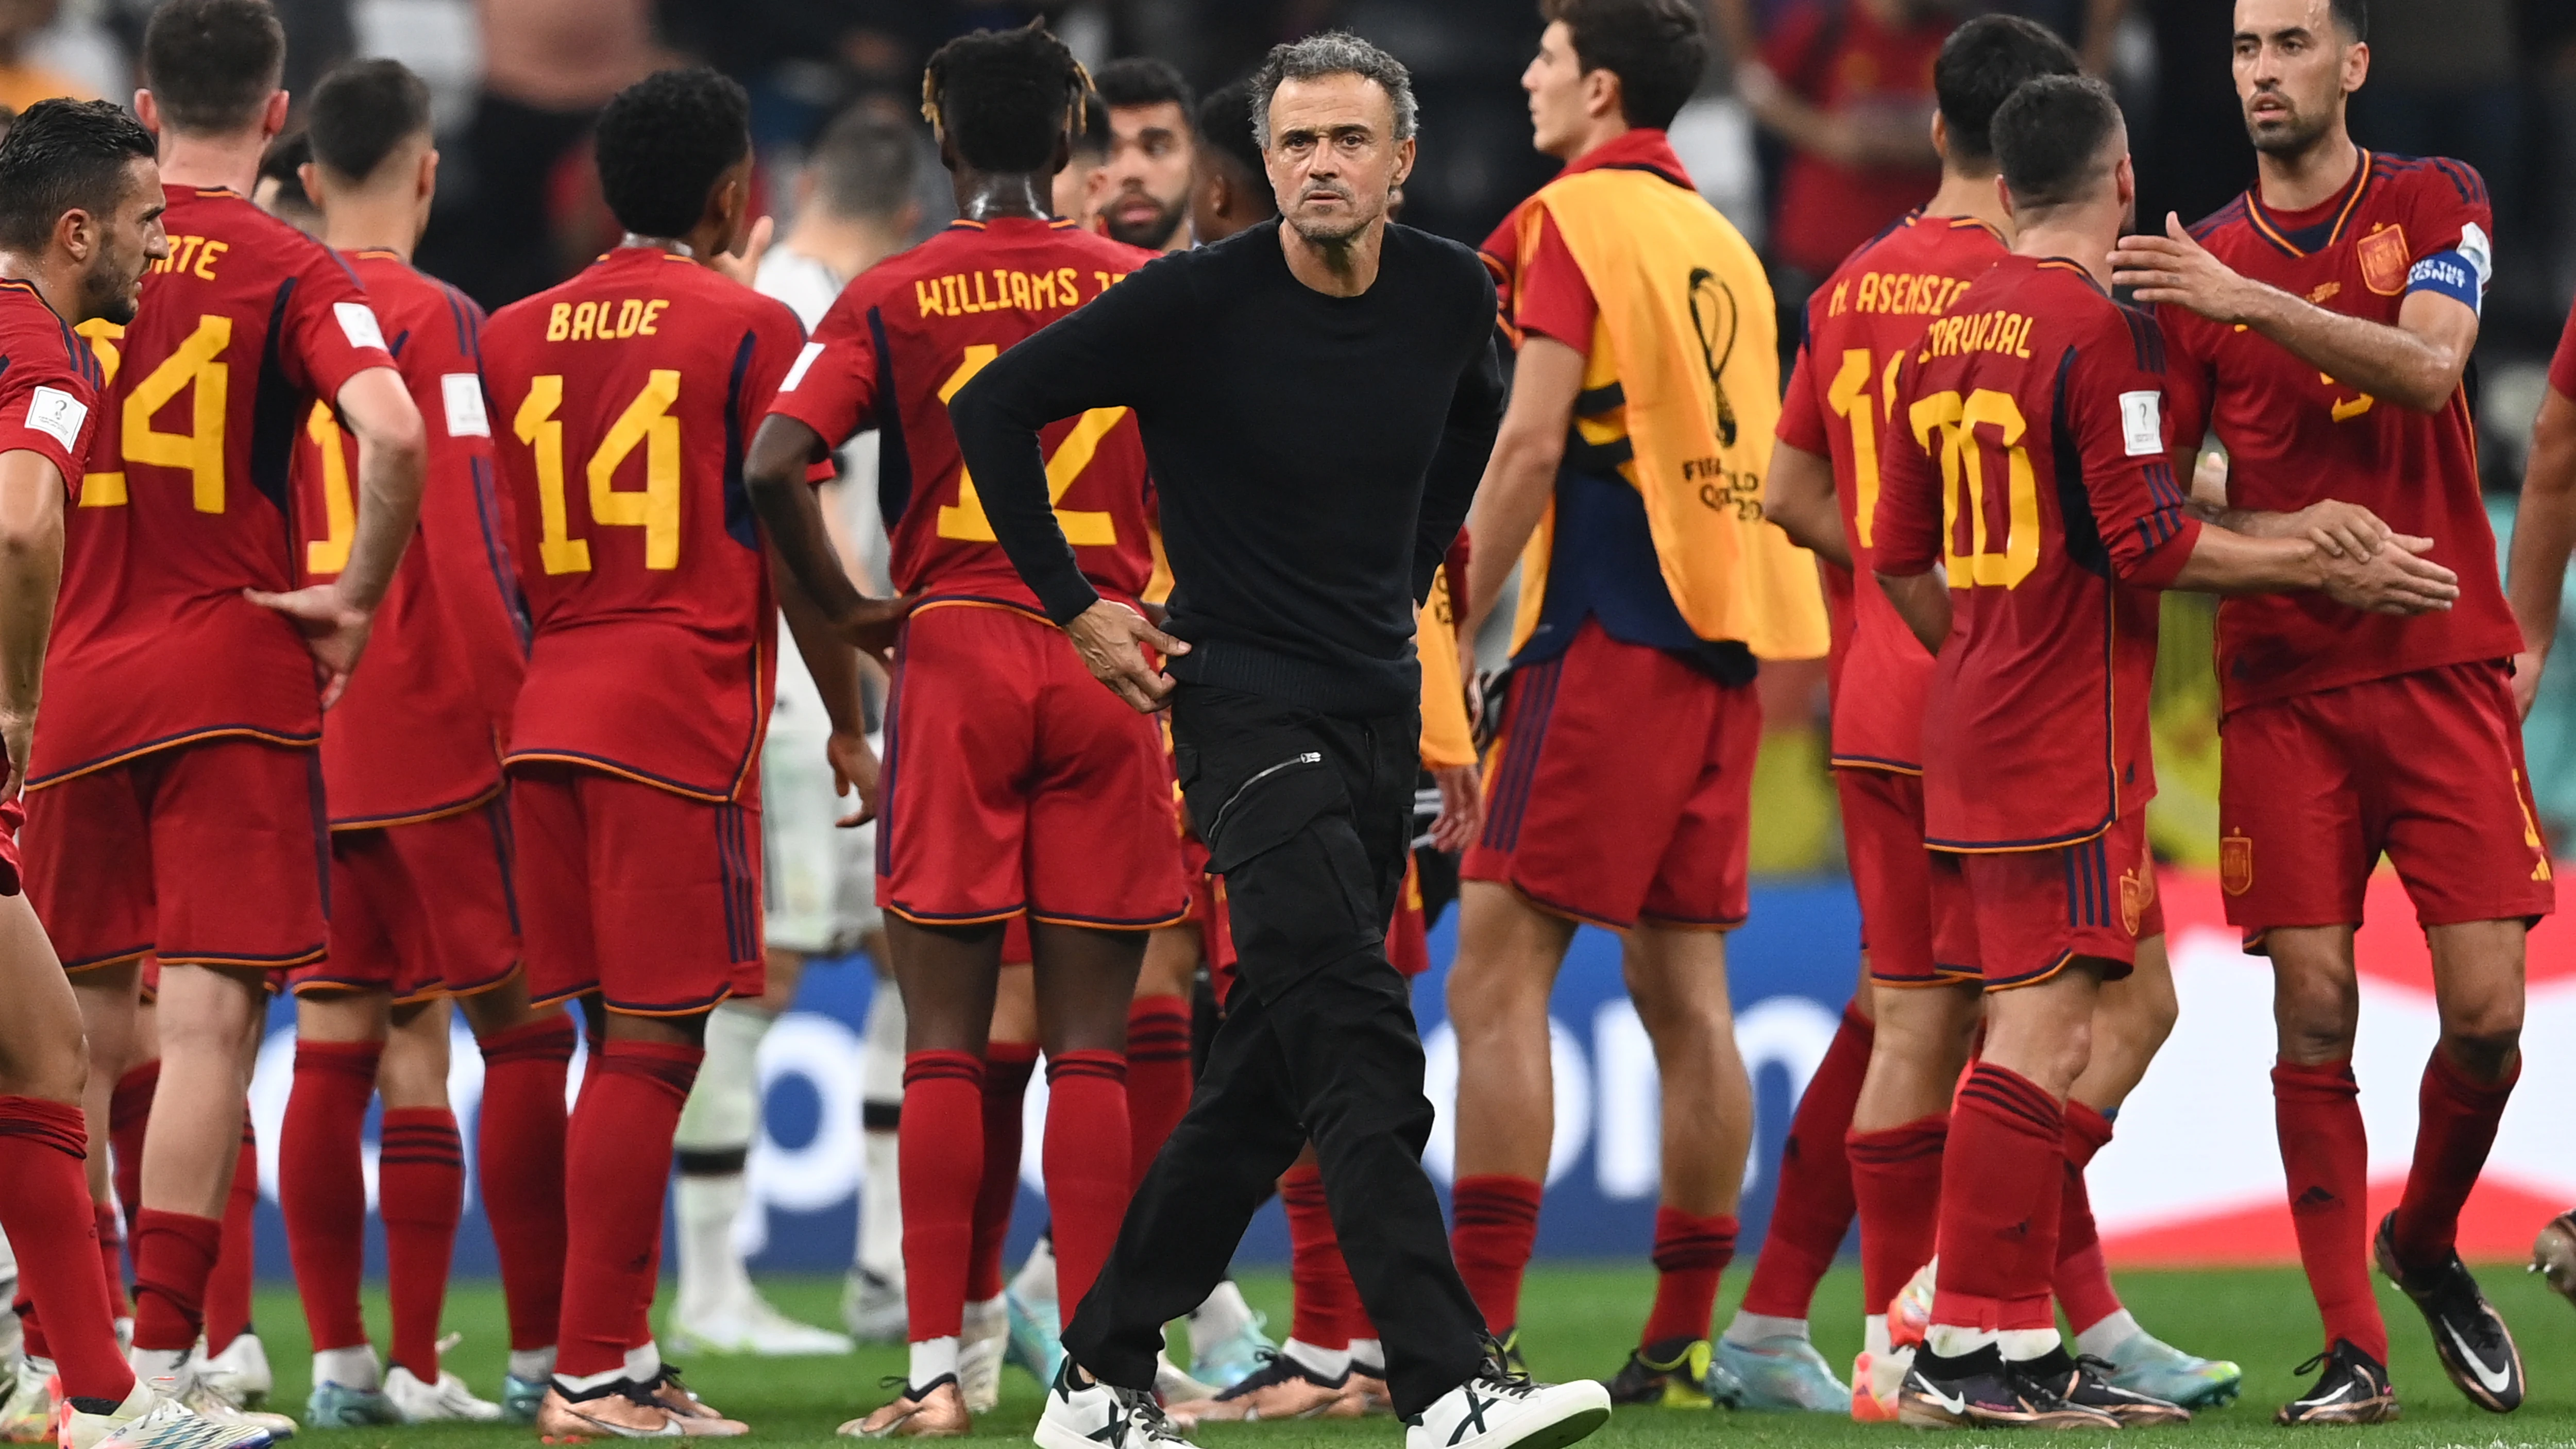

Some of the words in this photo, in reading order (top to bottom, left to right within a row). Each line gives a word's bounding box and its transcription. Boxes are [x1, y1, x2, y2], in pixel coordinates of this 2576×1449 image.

[916, 268, 1079, 318] WILLIAMS
[547, 299, 669, 341] BALDE
[514, 369, 681, 575] 14
